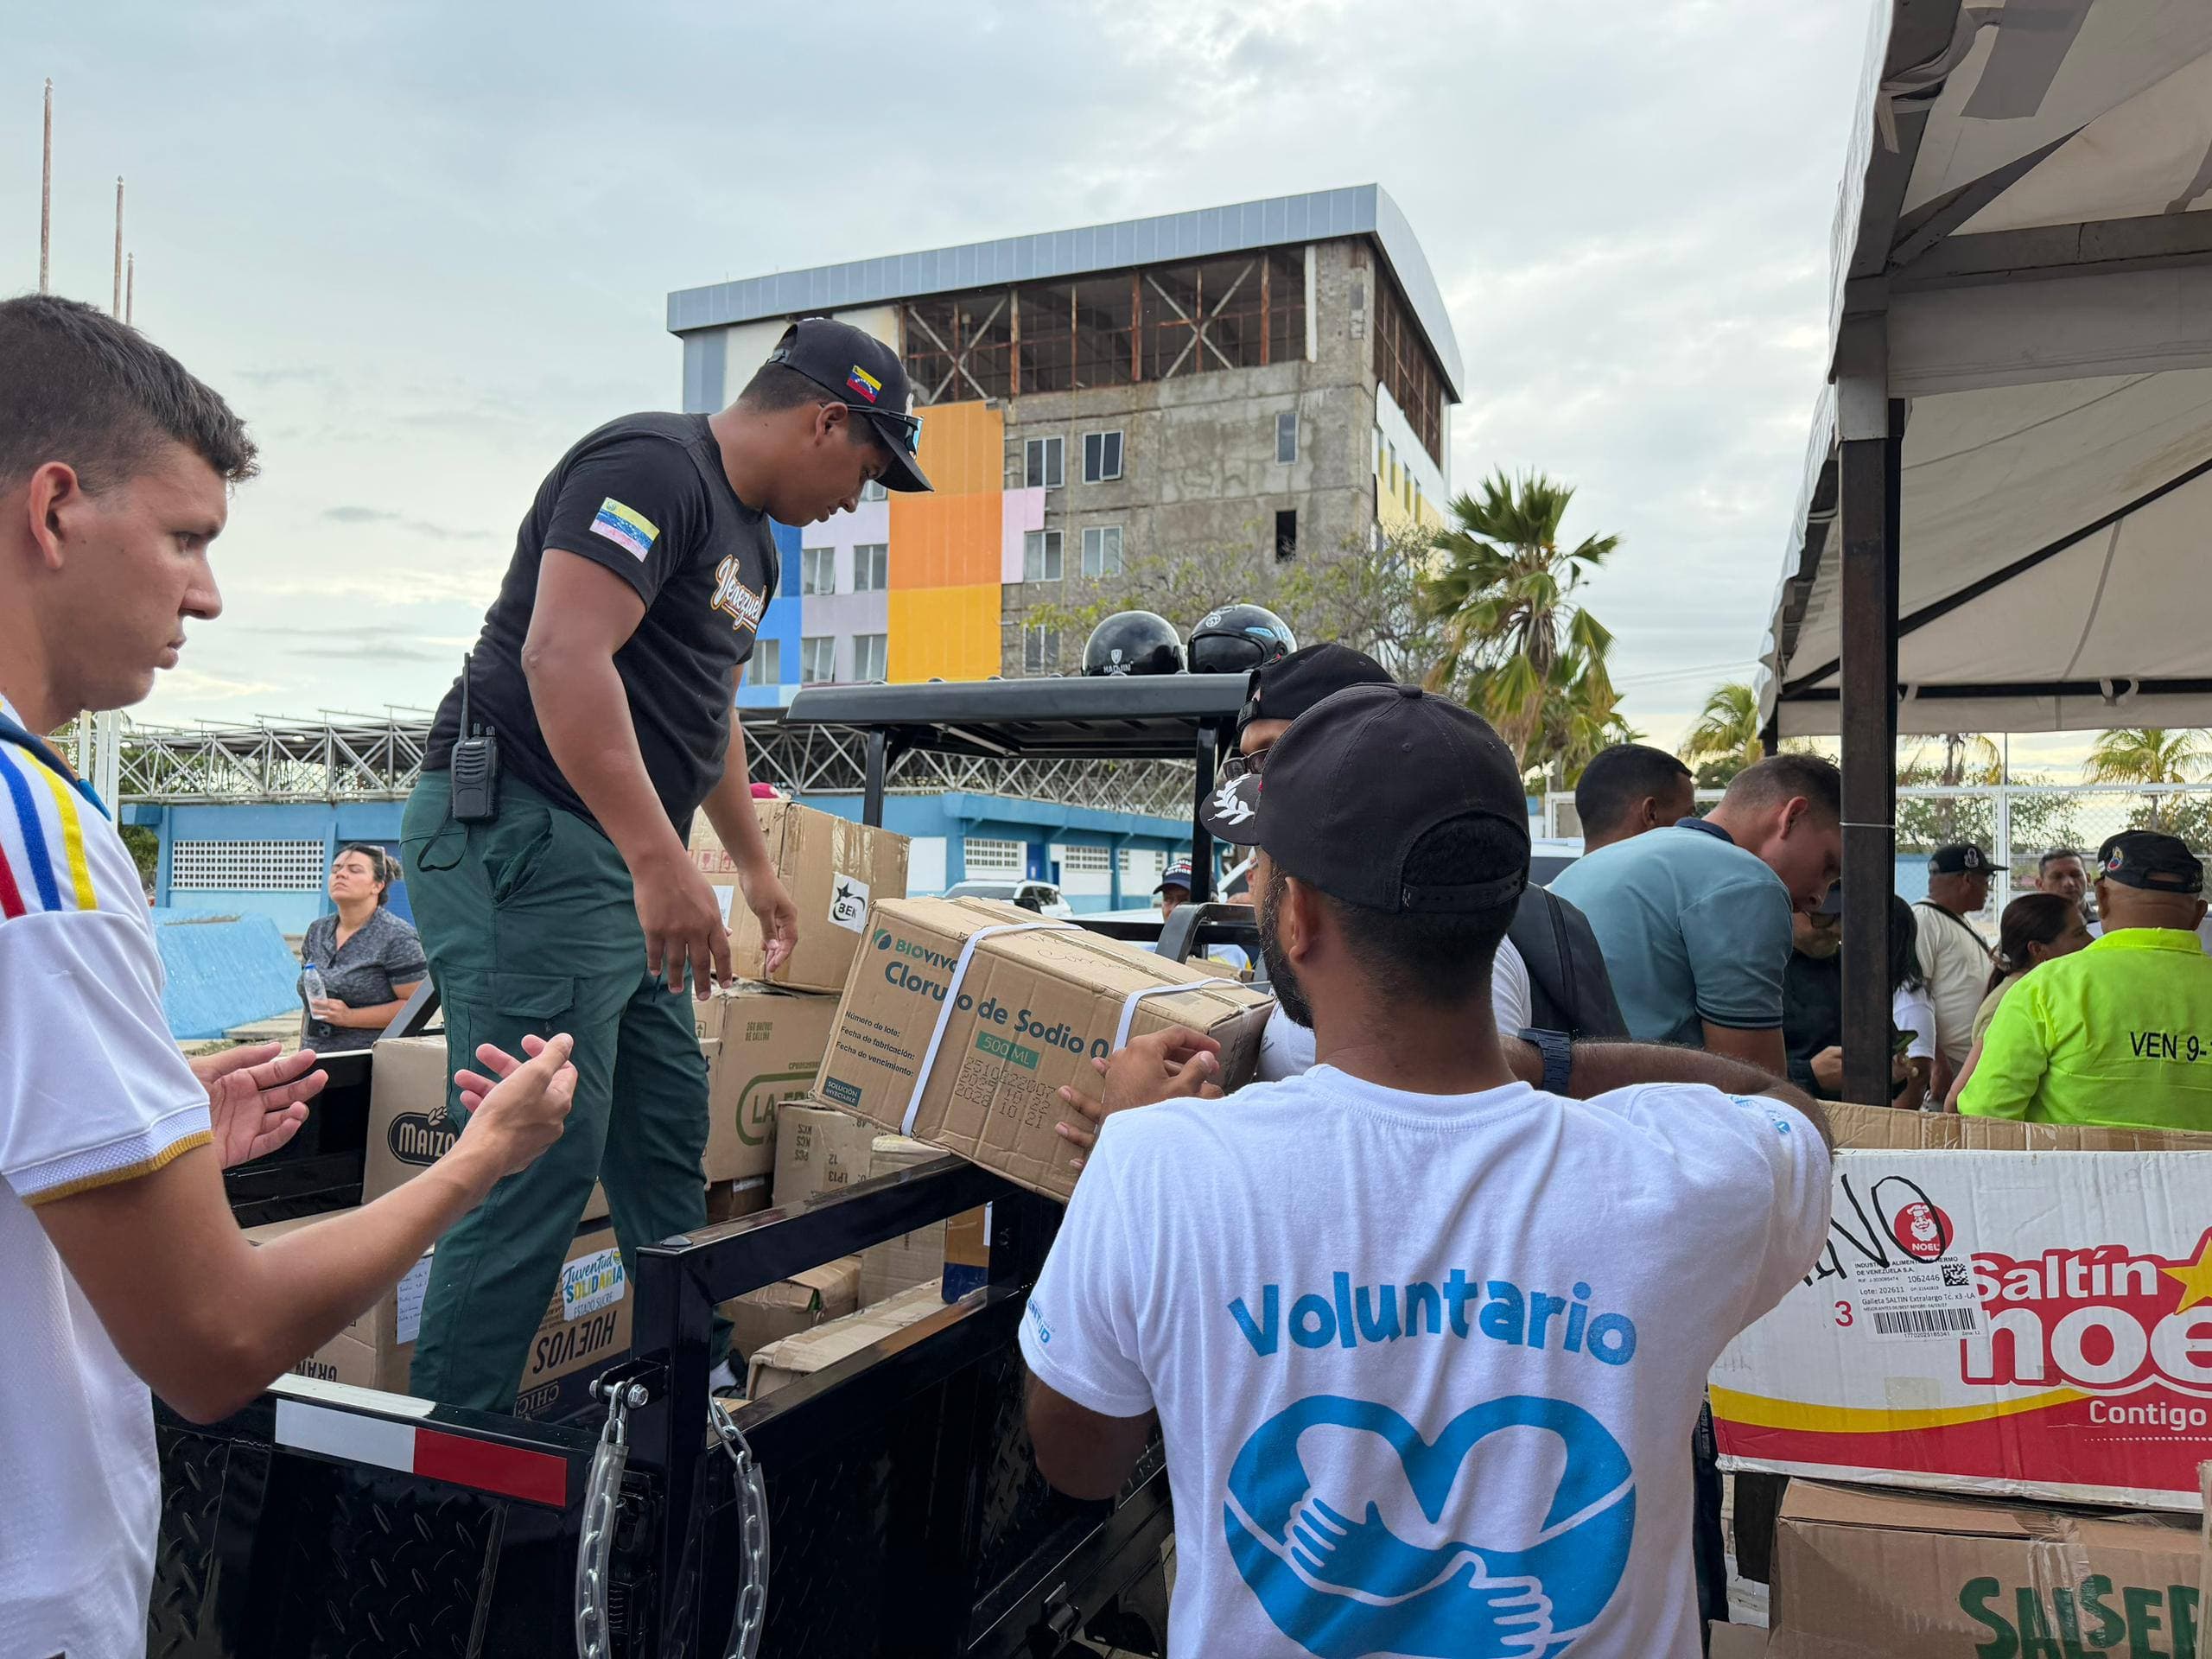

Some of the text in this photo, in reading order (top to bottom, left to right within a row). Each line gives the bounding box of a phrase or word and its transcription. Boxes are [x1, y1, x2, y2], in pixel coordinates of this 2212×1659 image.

[885, 962, 973, 1010] Cloruo
[978, 998, 1008, 1026] de
[1014, 1009, 1084, 1053] Sodio
[845, 1010, 872, 1027] Número
[884, 1026, 900, 1037] lote:
[836, 1041, 856, 1055] Fecha
[868, 1055, 914, 1077] vencimiento:
[841, 1026, 916, 1061] Fecha de fabricación:
[982, 1036, 1030, 1065] 500 ML
[2130, 1031, 2212, 1063] VEN 9-
[828, 1081, 857, 1096] SOLUCIÓN
[752, 1094, 775, 1124] LA
[1912, 1243, 1939, 1251] NOEL
[562, 1250, 614, 1291] Juventud
[566, 1264, 623, 1304] SOLIDARIA
[1907, 1274, 1940, 1283] 1062446
[1973, 1250, 2158, 1302] Saltín
[573, 1297, 596, 1319] ESTADO
[595, 1291, 613, 1311] SUCRE
[1834, 1300, 1853, 1327] 3
[1861, 1297, 1885, 1306] Galleta
[1909, 1294, 1942, 1303] Extralargo
[1227, 1268, 1637, 1366] Voluntario
[532, 1310, 617, 1375] HUEVOS
[2089, 1400, 2207, 1431] Contigo
